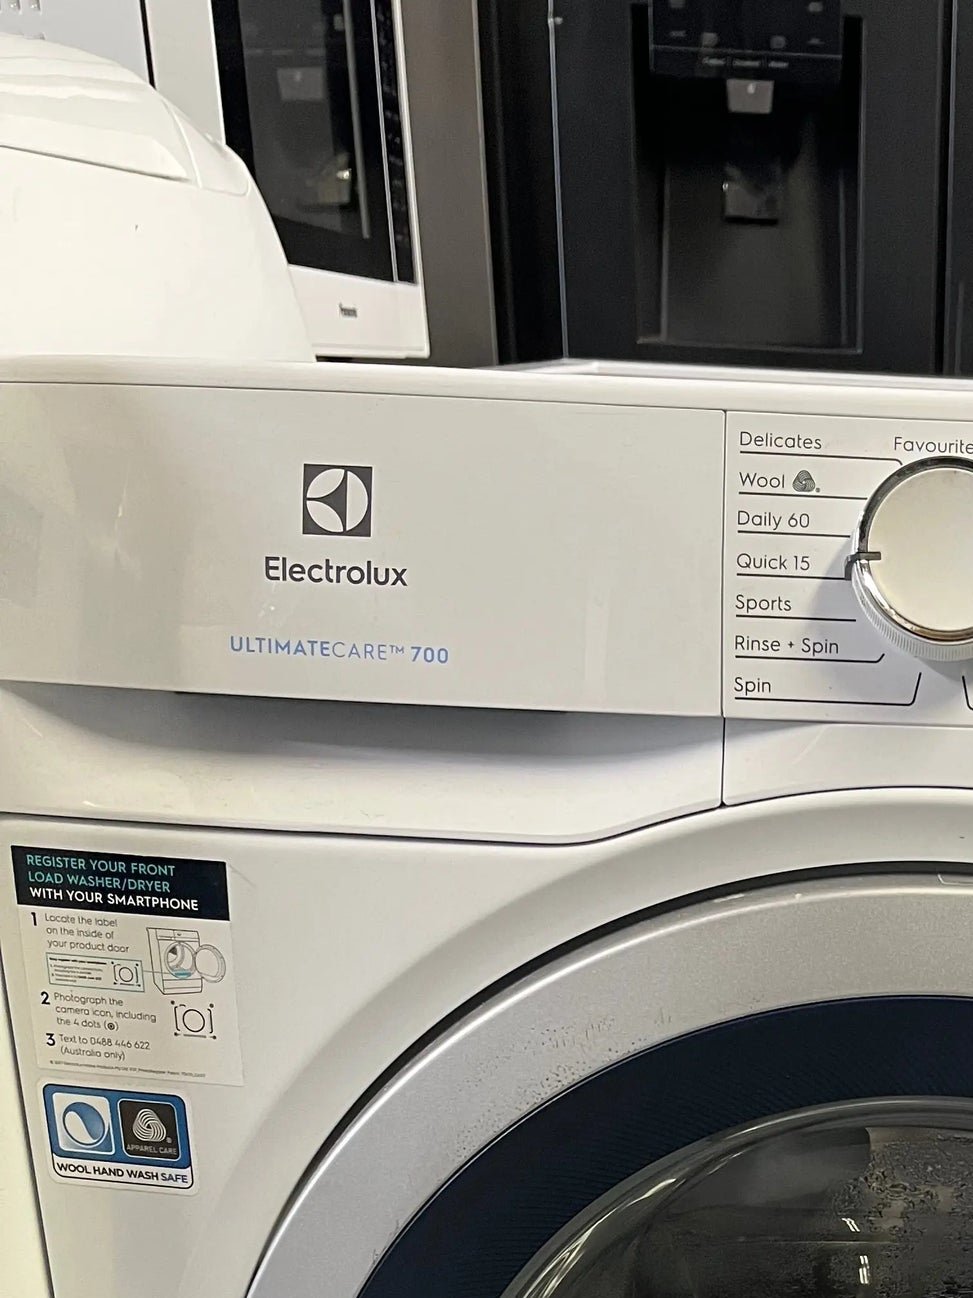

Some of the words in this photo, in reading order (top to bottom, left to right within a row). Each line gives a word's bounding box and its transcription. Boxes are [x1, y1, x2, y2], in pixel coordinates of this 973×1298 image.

[740, 431, 822, 450] Delicates
[739, 471, 785, 489] Wool
[737, 510, 782, 531] Daily
[788, 513, 810, 528] 60
[264, 555, 408, 587] Electrolux
[736, 552, 788, 571] Quick
[793, 555, 810, 571] 15
[736, 594, 792, 613] Sports
[411, 646, 449, 664] 700
[734, 635, 781, 652] Rinse
[801, 638, 839, 658] Spin
[734, 677, 771, 696] Spin
[26, 854, 86, 871] REGISTER
[90, 859, 127, 874] YOUR
[131, 863, 175, 877] FRONT
[28, 871, 64, 885] LOAD
[67, 874, 170, 893] WASHER/DRYER
[29, 887, 63, 901] WITH
[66, 889, 103, 905] YOUR
[107, 894, 199, 911] SMARTPHONE
[31, 911, 37, 927] 1
[45, 913, 77, 925] Locate
[78, 915, 93, 926] the
[95, 917, 118, 928] label
[46, 928, 58, 936] on
[60, 926, 75, 937] the
[77, 927, 103, 939] inside
[105, 930, 114, 940] of
[47, 939, 67, 950] your
[69, 940, 106, 953] product
[108, 943, 130, 954] door
[40, 990, 51, 1006] 2
[54, 992, 107, 1007] Photograph
[109, 996, 124, 1007] the
[55, 1005, 90, 1017] camera
[116, 1010, 157, 1024] including
[56, 1016, 71, 1026] the
[73, 1018, 80, 1027] 4
[81, 1018, 101, 1029] dots
[46, 1033, 56, 1047] 3
[58, 1033, 77, 1044] Text
[78, 1035, 88, 1045] to
[90, 1036, 113, 1047] 0488
[115, 1038, 132, 1048] 446
[134, 1040, 150, 1050] 622
[60, 1046, 101, 1058] (Australia
[104, 1050, 126, 1061] only)
[126, 1143, 158, 1154] APPAREL
[159, 1146, 177, 1156] CARE
[56, 1162, 92, 1175] WOOL
[93, 1166, 124, 1178] HAND
[127, 1169, 159, 1181] WASH
[160, 1172, 188, 1184] SAFE
